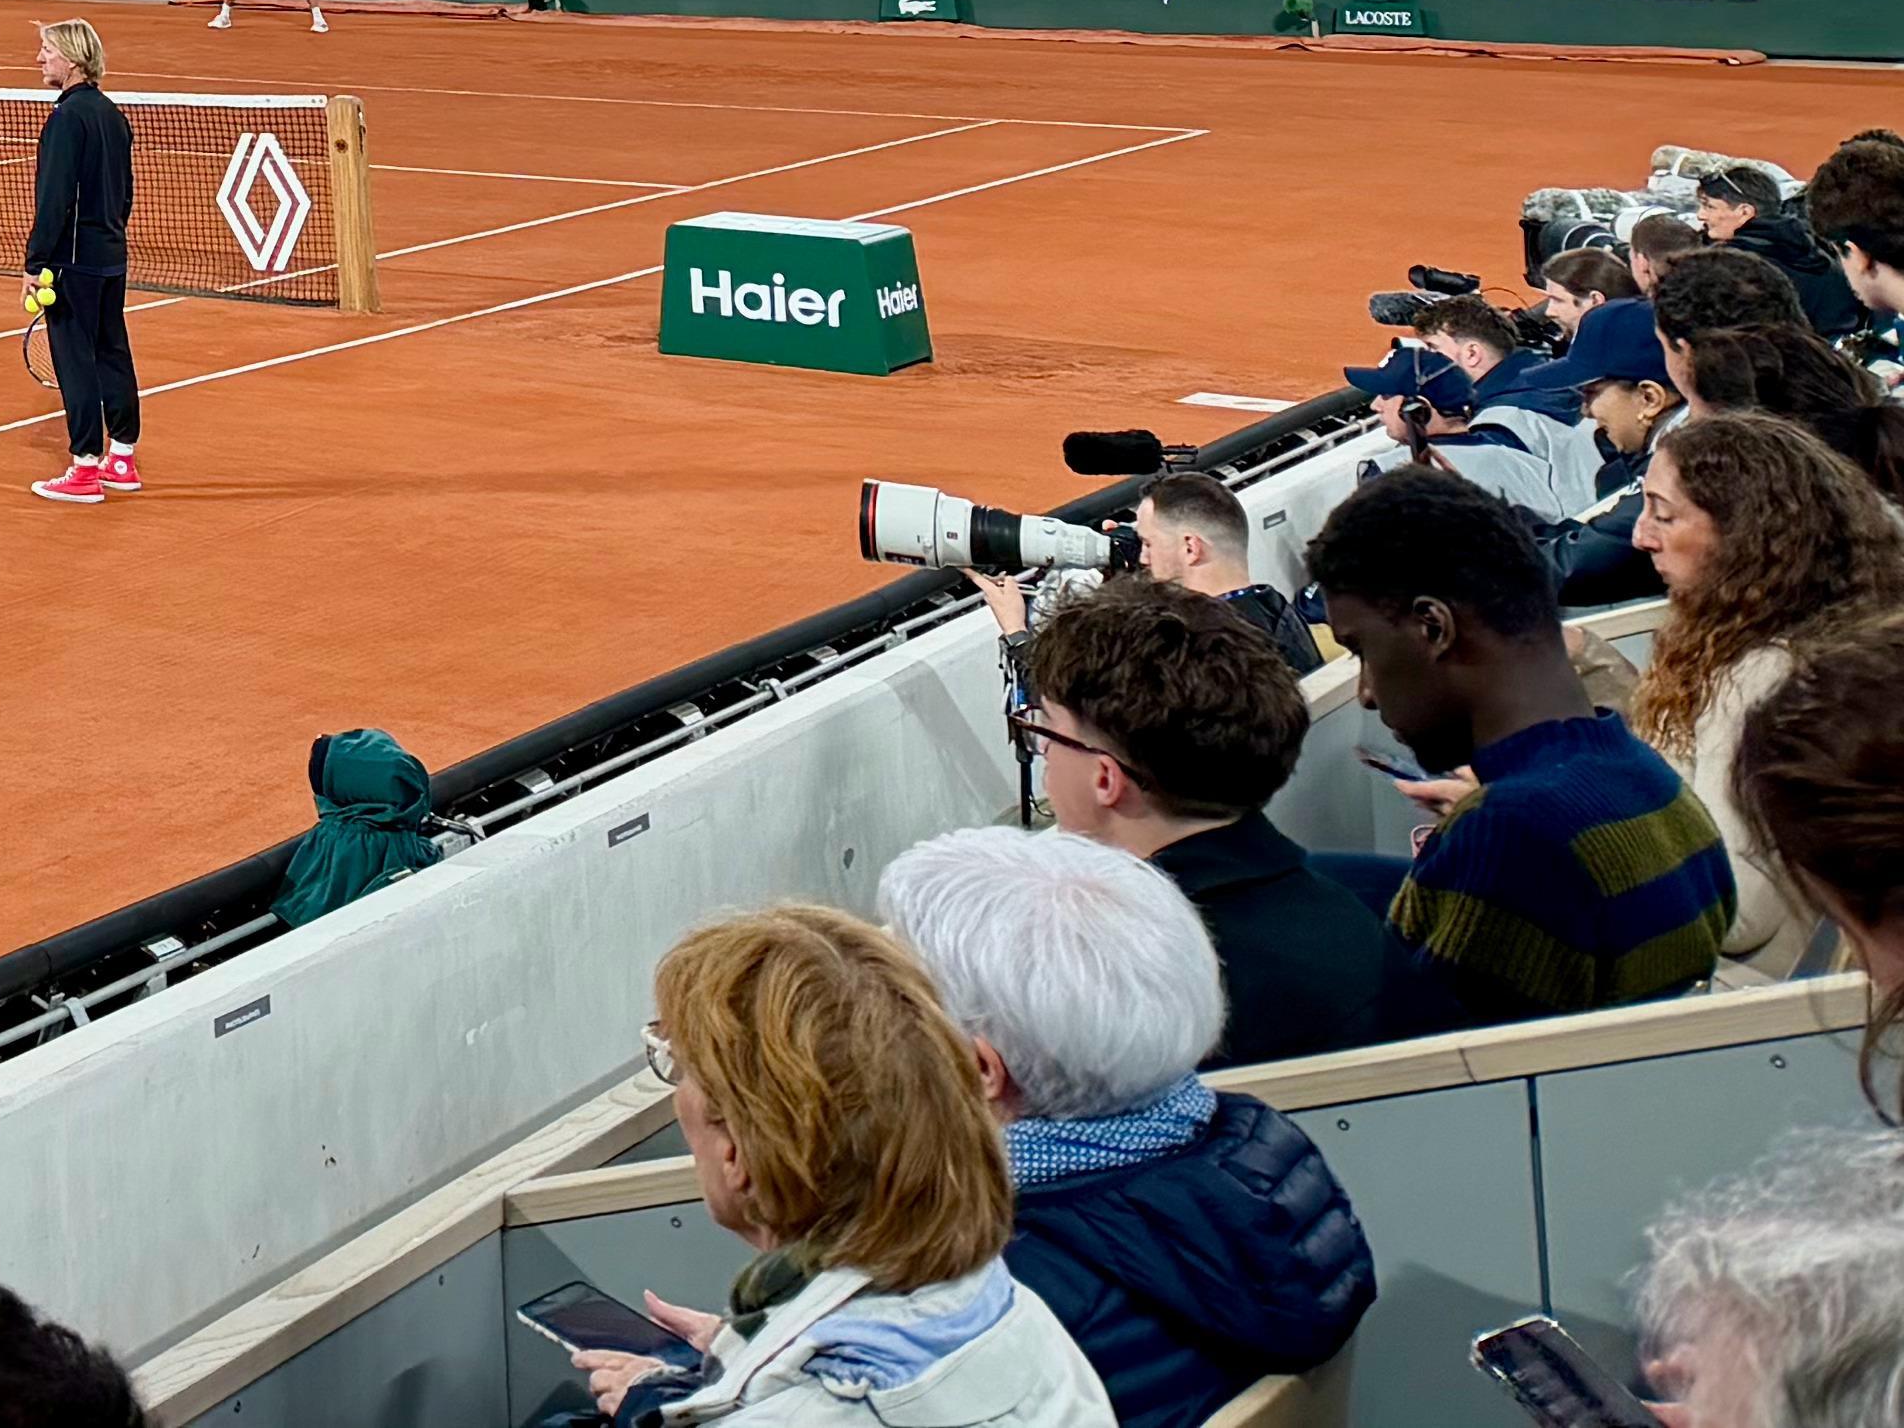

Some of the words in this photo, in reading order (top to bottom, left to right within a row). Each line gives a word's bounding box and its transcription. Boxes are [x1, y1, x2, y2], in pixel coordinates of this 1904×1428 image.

[1345, 10, 1412, 27] LACOSTE
[689, 267, 847, 328] Haier
[876, 281, 918, 319] Haier
